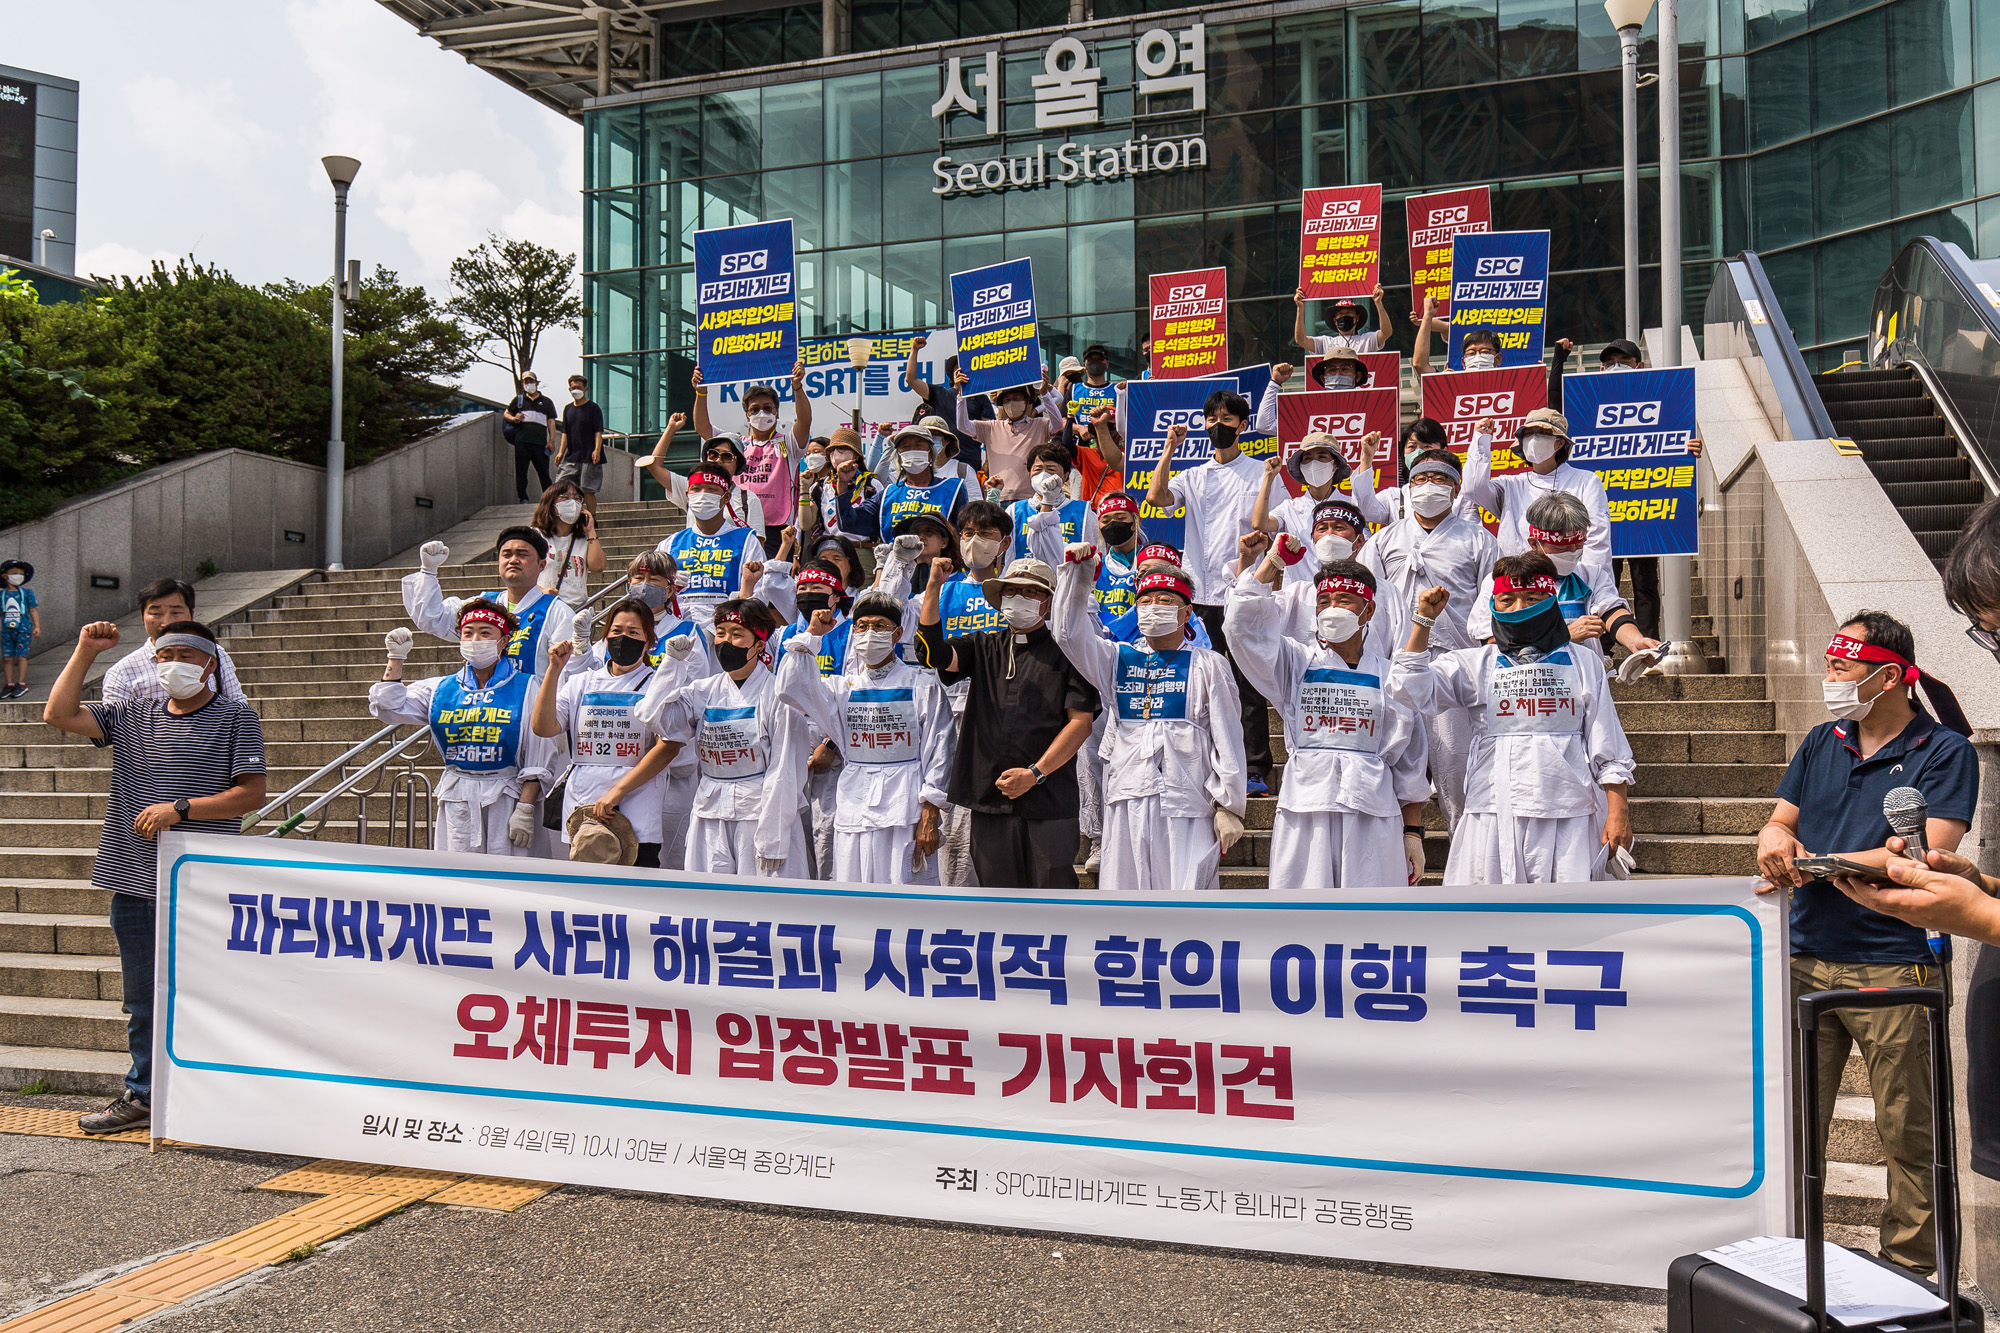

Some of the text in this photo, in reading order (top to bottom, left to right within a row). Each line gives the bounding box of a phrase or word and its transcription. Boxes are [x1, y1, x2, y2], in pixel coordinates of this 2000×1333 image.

[932, 22, 1206, 135] 서울역
[932, 134, 1207, 194] Seoul Station
[1323, 201, 1359, 216] SPC
[1430, 207, 1467, 226] SPC
[1306, 216, 1376, 233] 파리바게뜨
[1316, 234, 1369, 251] 불법행위
[722, 252, 765, 273] SPC
[1302, 251, 1377, 268] 윤석열정부가
[1478, 259, 1521, 274] SPC
[1310, 268, 1367, 284] 처벌하라!
[703, 275, 790, 302] 파리바게뜨
[974, 285, 1011, 305] SPC
[1170, 285, 1205, 301] SPC
[1456, 281, 1541, 300] 파리바게뜨
[699, 301, 795, 331] 사회적합의를
[959, 301, 1031, 331] 파리바게뜨
[1154, 299, 1223, 319] 파리바게뜨
[1451, 306, 1544, 326] 사회적합의를
[1164, 318, 1216, 336] 불법행위
[712, 330, 783, 355] 이행하라!
[958, 322, 1035, 352] 사회적합의를
[1153, 333, 1226, 353] 윤석열정부가
[970, 345, 1027, 371] 이행하라!
[1161, 351, 1216, 368] 처벌하라!
[1078, 397, 1114, 406] 파리바게뜨
[1089, 389, 1105, 397] SPC
[1457, 394, 1511, 416] SPC
[1600, 403, 1657, 425] SPC
[1156, 411, 1205, 430] SPC
[1311, 415, 1362, 435] SPC
[1572, 432, 1687, 459] 파리바게뜨
[905, 490, 931, 500] SPC
[1108, 499, 1127, 508] 투쟁
[1608, 498, 1678, 522] 행하라!
[695, 536, 721, 548] SPC
[677, 547, 734, 562] 파리바게뜨
[682, 559, 726, 577] 노조탄압
[1152, 575, 1176, 587] 투쟁
[1341, 578, 1366, 594] 투쟁
[1831, 636, 1863, 659] 투쟁
[462, 690, 495, 706] SPC
[1496, 697, 1575, 717] 오체투지
[437, 706, 512, 724] 파리바게뜨
[445, 725, 502, 744] 노조탄압
[1303, 715, 1375, 737] 오체투지
[577, 741, 641, 757] 단식 32 일차
[850, 731, 911, 749] 오체투지
[700, 747, 756, 766] 오체투지
[226, 893, 1628, 1031] 파리바게뜨 사태 해결과 사회적 합의 이행 촉구
[453, 993, 1295, 1121] 오체투지 입장발표 기자회견
[361, 1114, 399, 1138] 일시
[402, 1118, 423, 1140] 및
[426, 1120, 464, 1144] 장소
[477, 1125, 511, 1149] 8월
[513, 1128, 576, 1156] 4일(목)
[582, 1134, 620, 1159] 10시
[624, 1138, 668, 1164] 30분
[672, 1142, 683, 1165] /
[687, 1143, 747, 1172] 서울역
[753, 1149, 836, 1179] 중앙계단
[935, 1166, 978, 1193] 주최
[995, 1171, 1148, 1207] SPC파리바게뜨
[1155, 1184, 1227, 1214] 노동자
[1234, 1191, 1307, 1221] 힘내라
[1314, 1198, 1414, 1231] 공동행동
